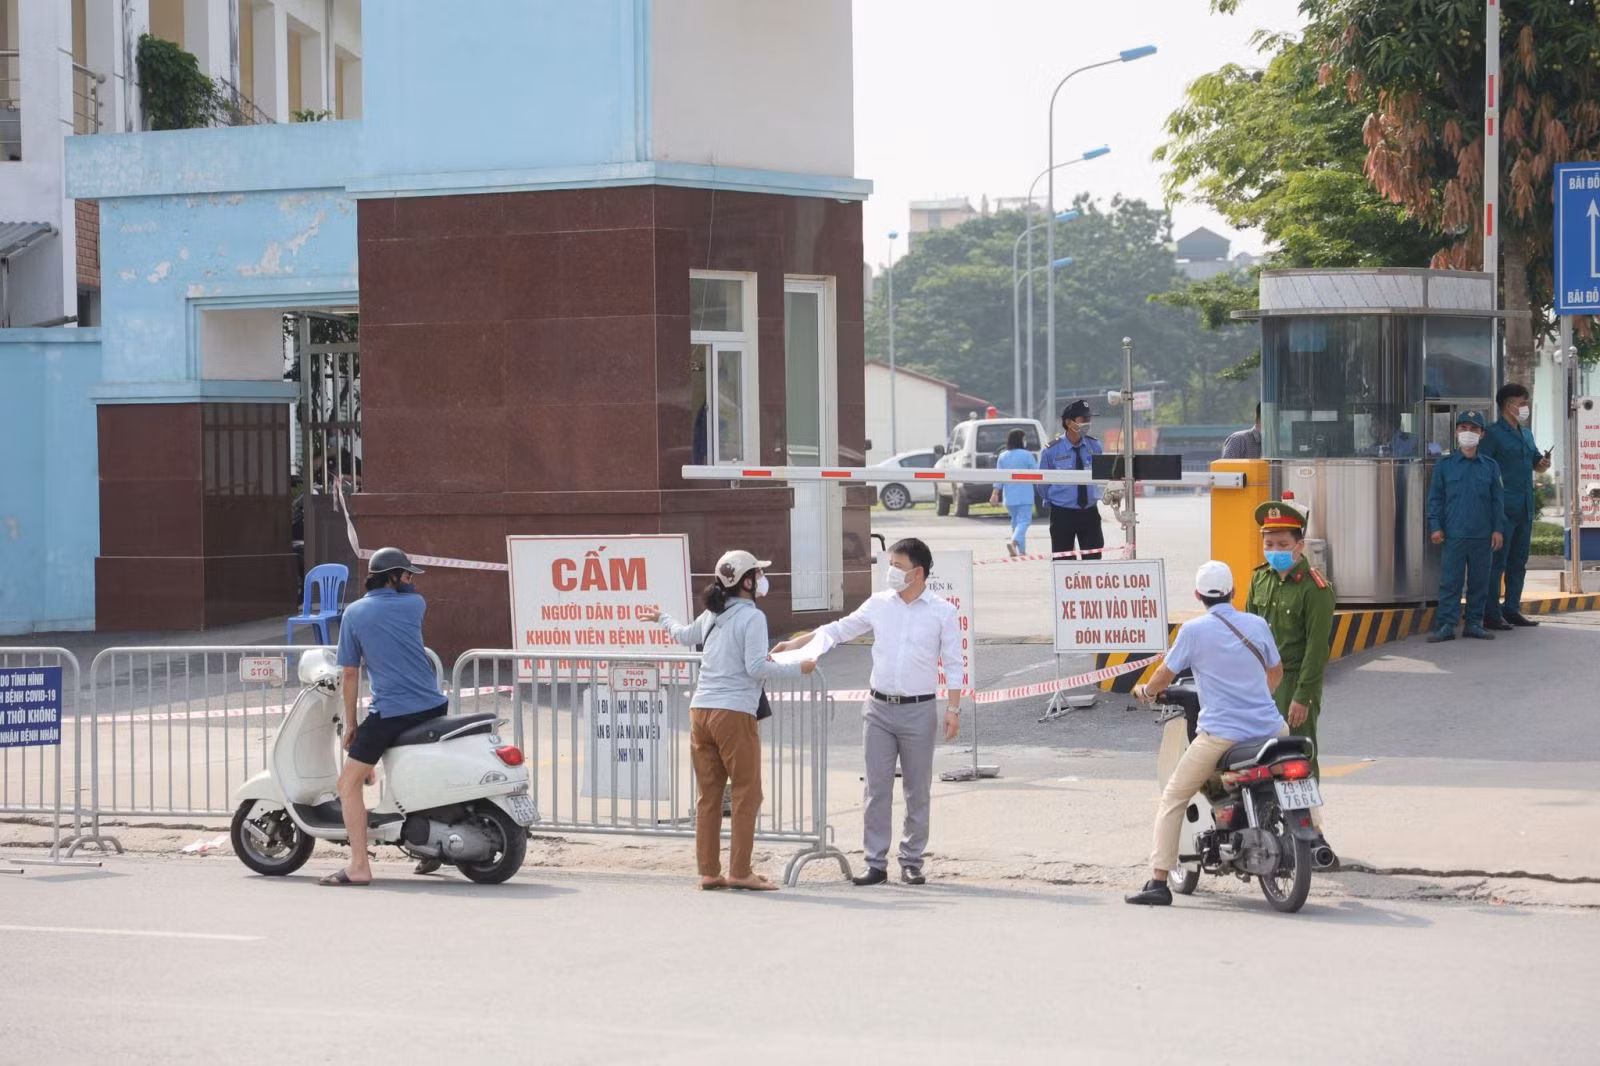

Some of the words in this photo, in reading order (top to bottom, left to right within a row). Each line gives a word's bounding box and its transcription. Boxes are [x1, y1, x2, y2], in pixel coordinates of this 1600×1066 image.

[551, 546, 647, 591] CẤM
[929, 581, 945, 592] IỆN
[1065, 570, 1092, 589] CẤM
[1095, 572, 1120, 589] CÁC
[1123, 574, 1150, 591] LOẠI
[541, 602, 582, 621] NGƯỜI
[585, 602, 613, 620] DÂN
[617, 605, 631, 620] ĐI
[1062, 600, 1077, 620] XE
[1079, 600, 1102, 619] TAXI
[1105, 596, 1128, 619] VÀO
[1131, 595, 1157, 622] VIỆN
[526, 628, 571, 645] KHUÔN
[574, 628, 605, 645] VIÊN
[609, 627, 645, 648] BỆNH
[1076, 627, 1101, 644] ĐÓN
[1104, 626, 1146, 644] KHÁCH
[623, 678, 648, 687] STOP
[5, 688, 24, 706] BỆNH
[25, 689, 56, 702] COVID-19
[7, 706, 26, 724] THỜI
[27, 706, 57, 723] KHÔNG
